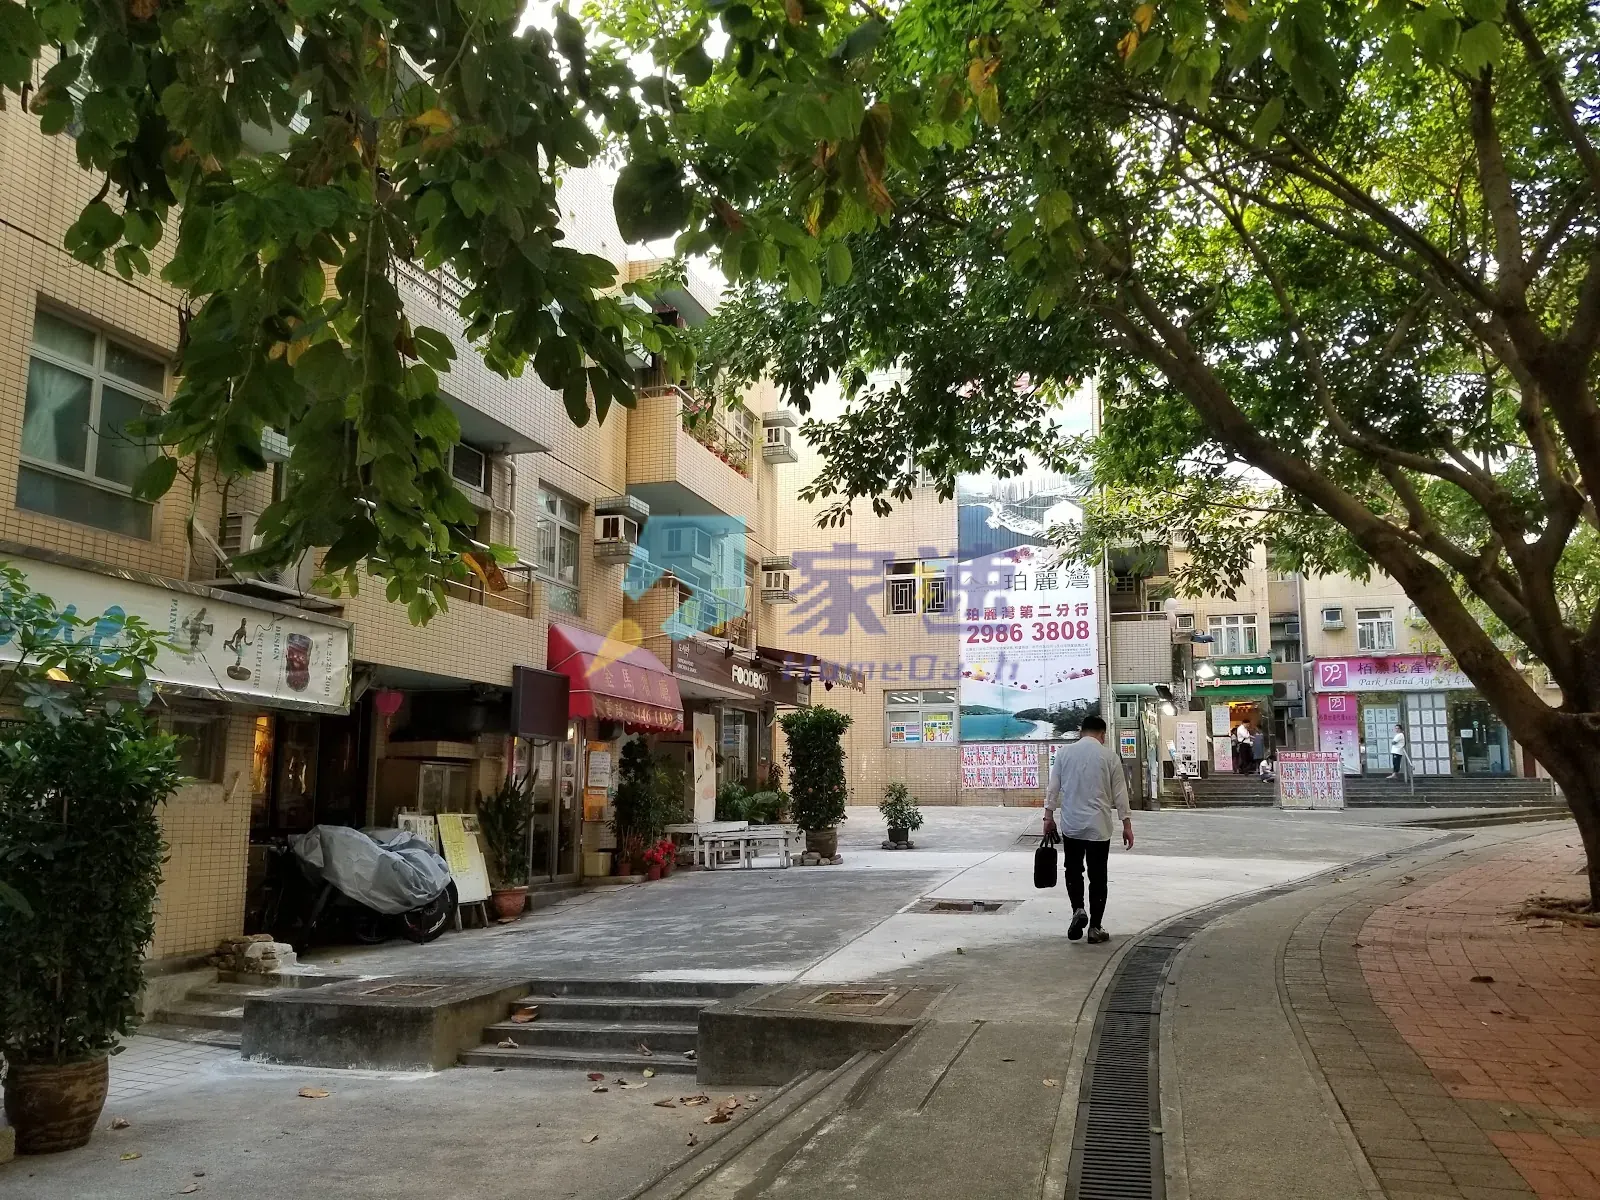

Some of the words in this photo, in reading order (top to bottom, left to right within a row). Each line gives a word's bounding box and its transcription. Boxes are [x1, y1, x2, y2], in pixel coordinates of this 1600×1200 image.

[1004, 568, 1090, 591] 珀麗灣
[168, 598, 179, 645] PAINTIN
[966, 603, 1089, 621] 珀麗灣第二分行
[273, 626, 281, 660] DESIGN
[966, 623, 1023, 643] 2986
[1031, 620, 1090, 641] 3808
[253, 631, 264, 689] SCULPTURE
[1213, 665, 1267, 676] 教育中心
[731, 664, 768, 691] FOODBOX
[1359, 678, 1383, 687] Park
[1385, 675, 1413, 685] Island
[654, 711, 673, 726] 1139
